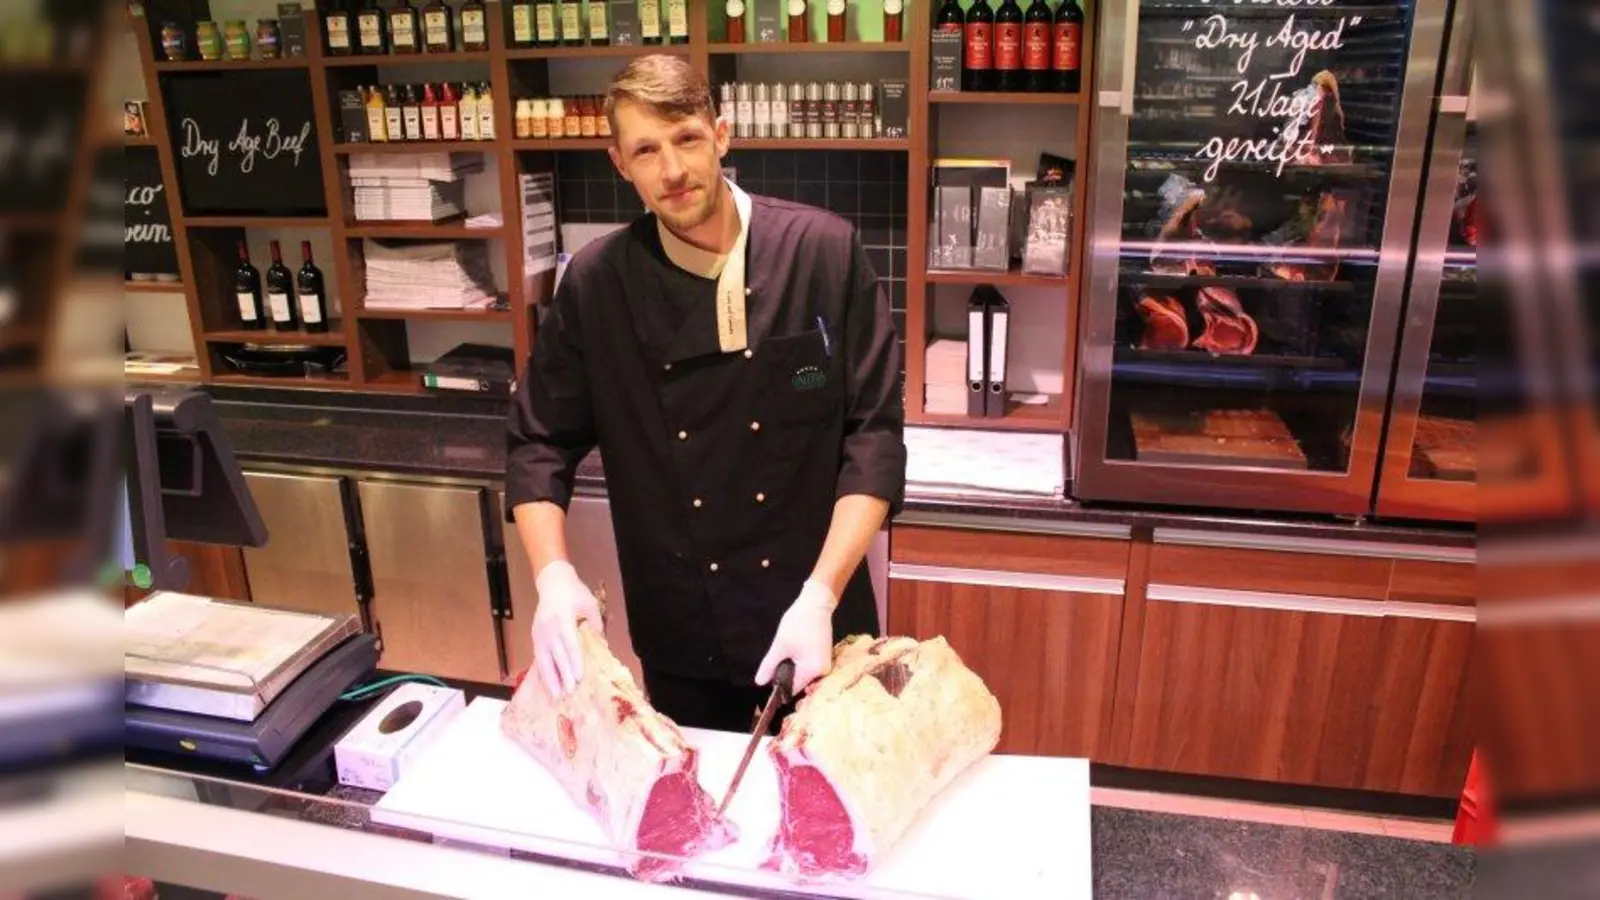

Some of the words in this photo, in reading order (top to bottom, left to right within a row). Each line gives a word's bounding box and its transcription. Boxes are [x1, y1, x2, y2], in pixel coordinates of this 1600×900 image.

[182, 118, 219, 176] Dry
[229, 118, 260, 173] Age
[263, 117, 311, 167] Beef
[125, 184, 163, 205] co
